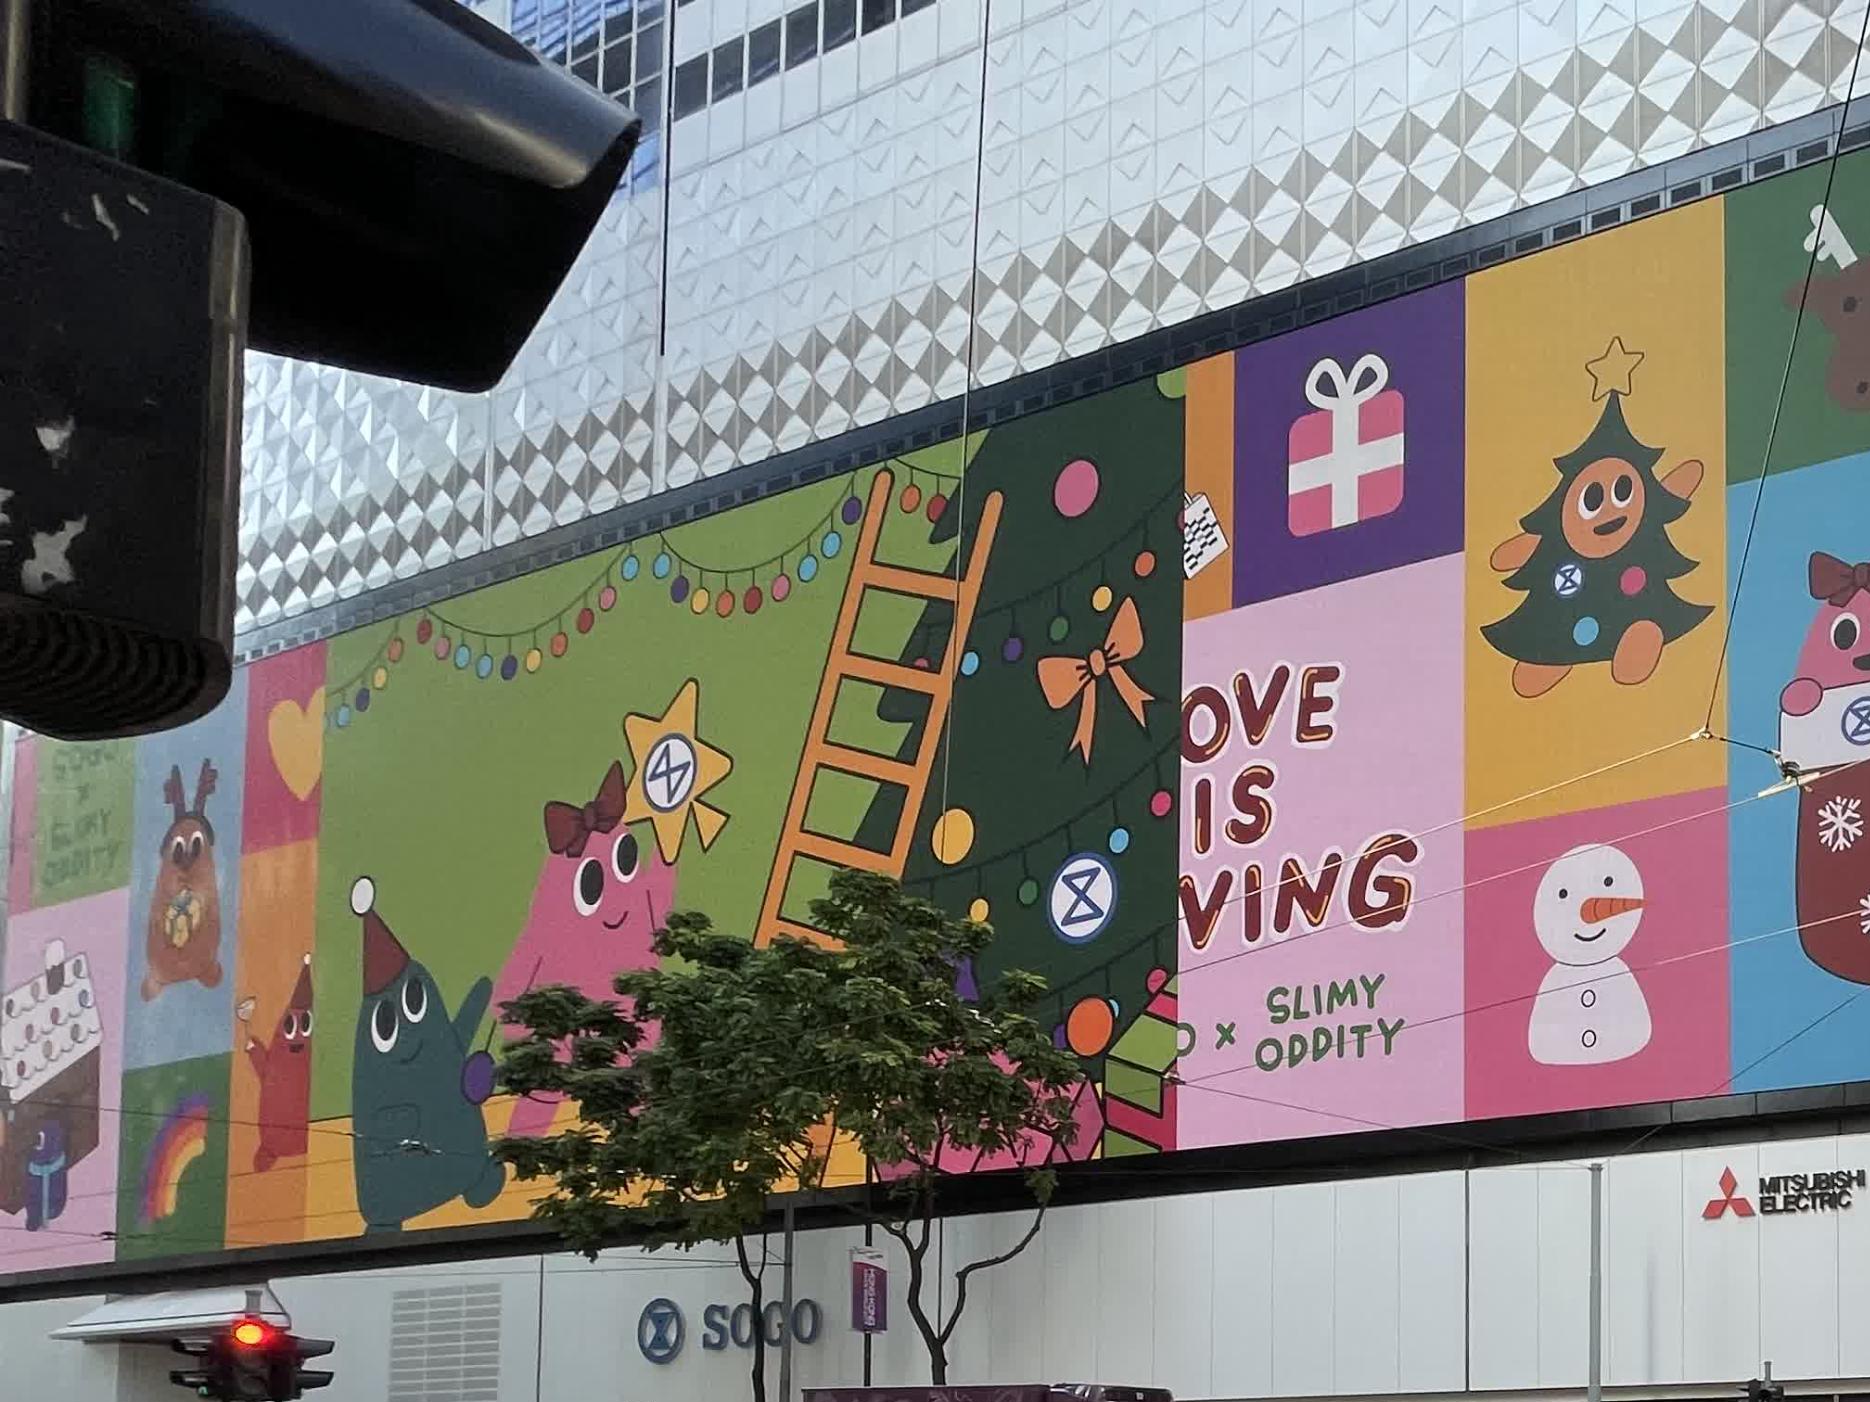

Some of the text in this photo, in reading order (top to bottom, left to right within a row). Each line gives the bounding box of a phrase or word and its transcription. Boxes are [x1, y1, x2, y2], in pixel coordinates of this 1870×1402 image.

[1193, 765, 1275, 855] IS
[1179, 833, 1419, 950] VING
[1266, 974, 1386, 1023] SLIMY
[1255, 1018, 1405, 1072] ODDITY
[1759, 1169, 1867, 1195] MITSUBISHI
[1759, 1190, 1853, 1215] ELECTRIC
[703, 1299, 822, 1351] SOGO
